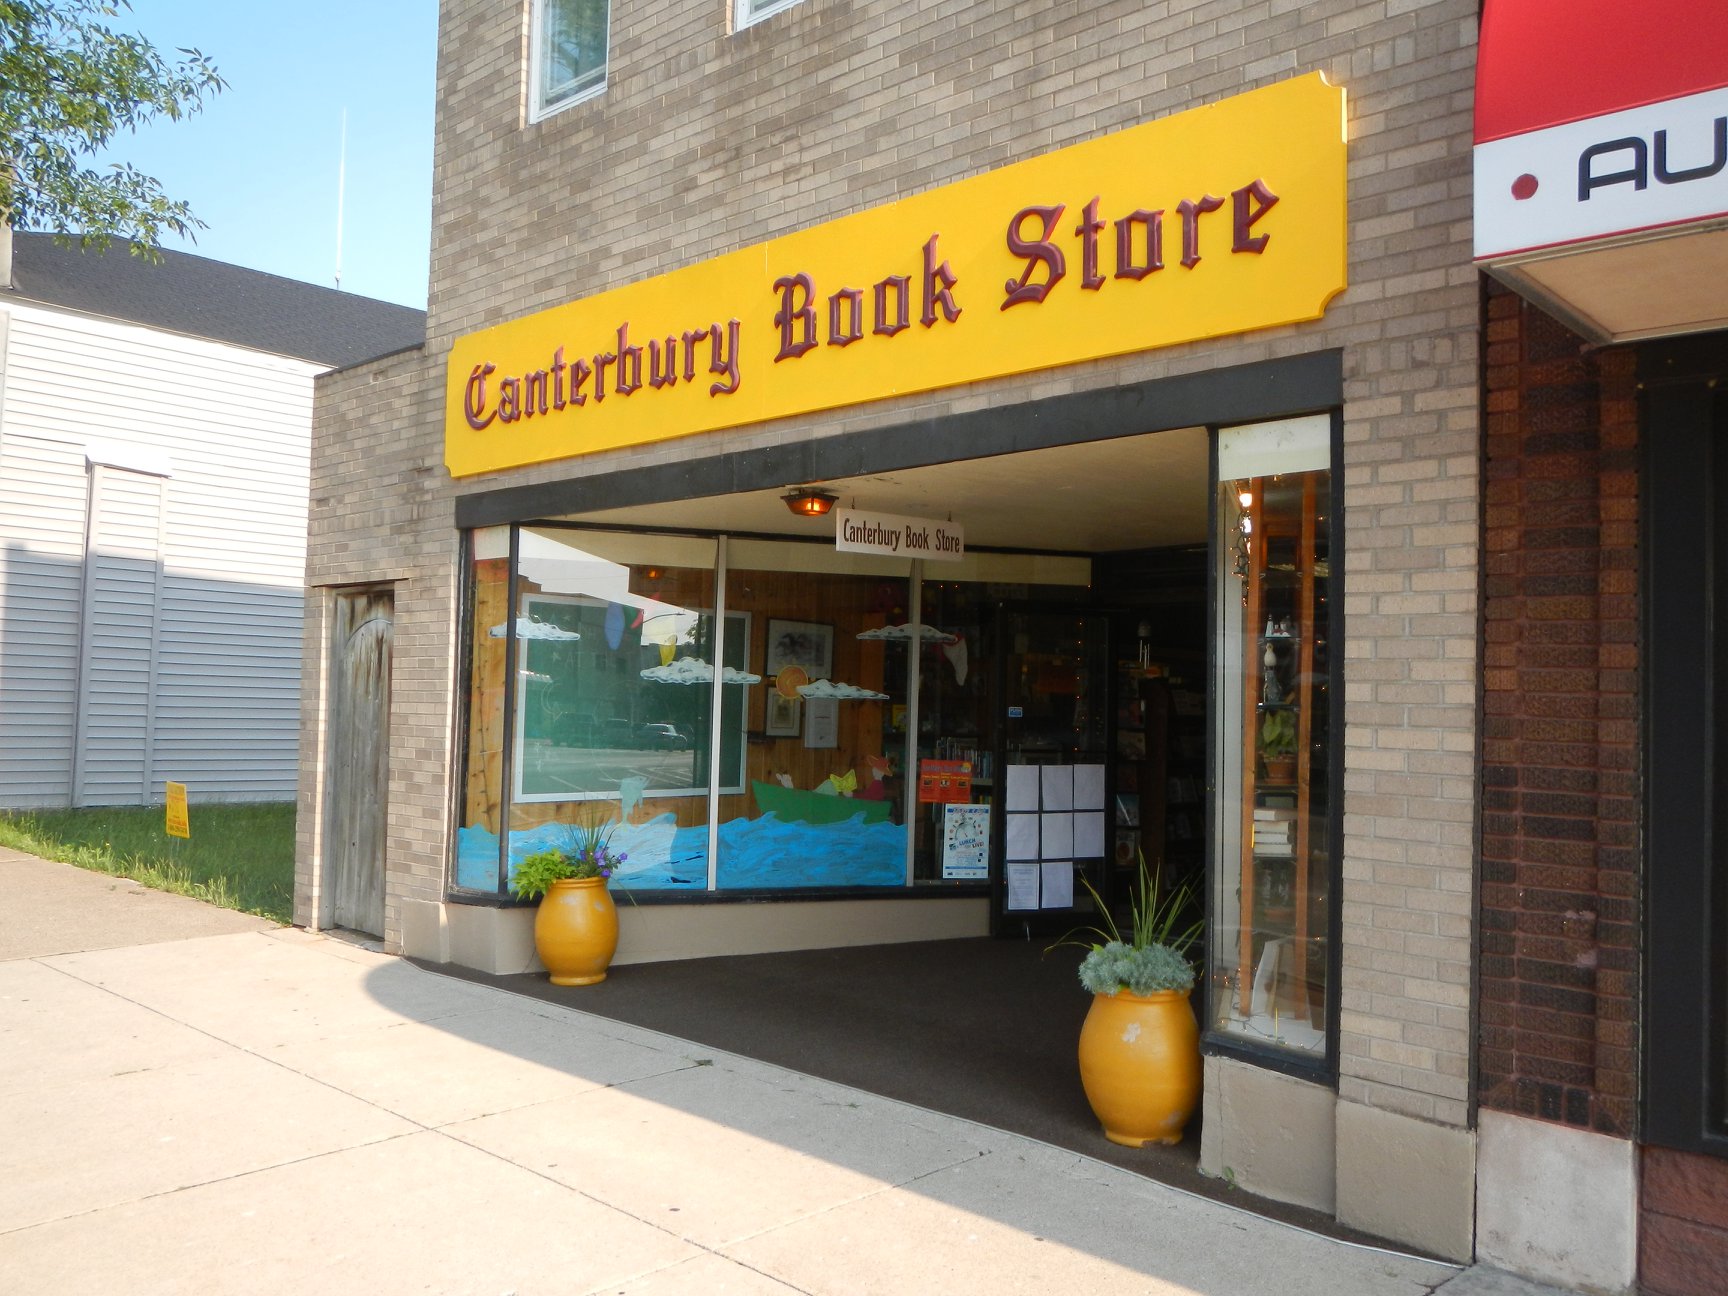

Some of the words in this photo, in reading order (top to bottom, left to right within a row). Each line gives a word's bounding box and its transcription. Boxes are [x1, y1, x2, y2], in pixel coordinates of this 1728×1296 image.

[1577, 116, 1728, 202] AU
[464, 320, 742, 431] Canterbury
[772, 233, 963, 364] Book
[1000, 178, 1280, 311] Store
[843, 517, 901, 551] Canterbury
[905, 525, 930, 550] Book
[935, 529, 960, 553] Store
